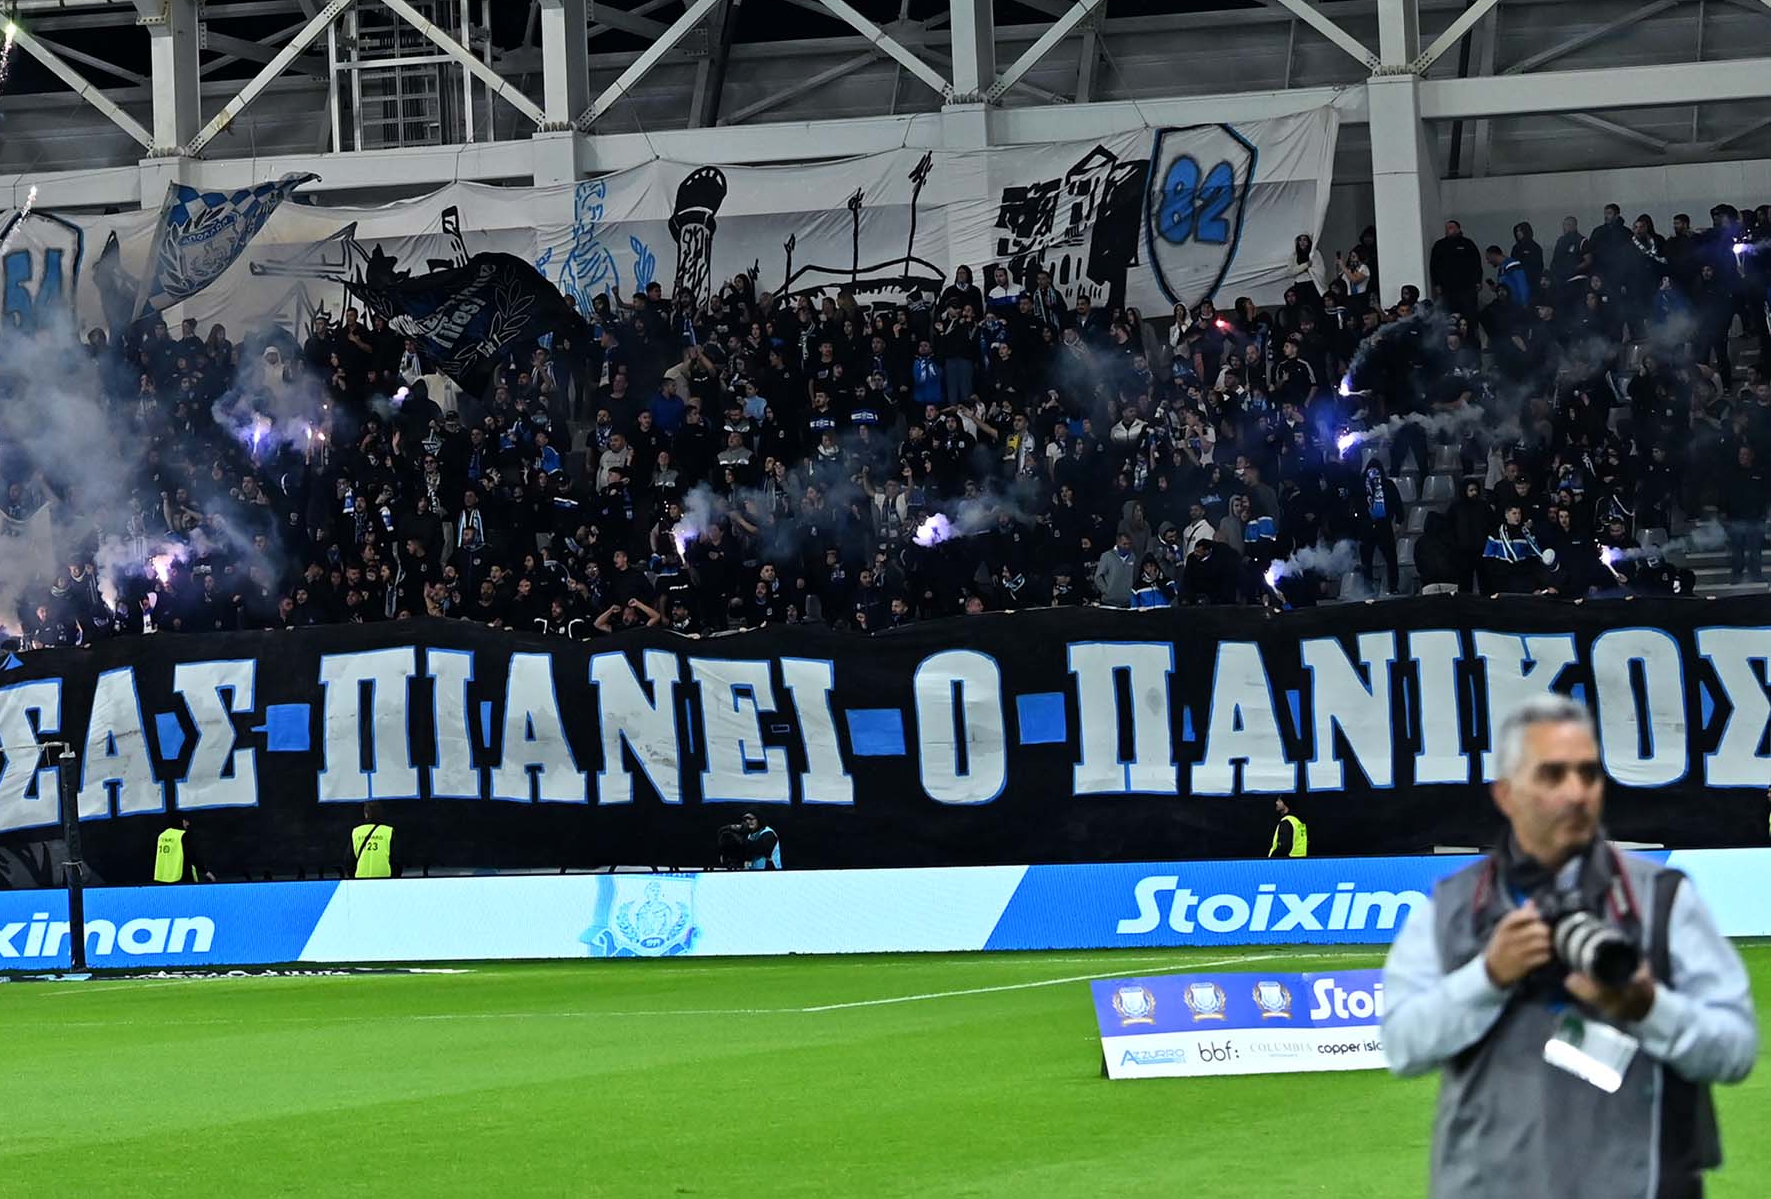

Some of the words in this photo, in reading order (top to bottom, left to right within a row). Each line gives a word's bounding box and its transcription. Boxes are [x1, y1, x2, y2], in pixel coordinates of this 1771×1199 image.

[1156, 155, 1234, 244] 82
[317, 646, 854, 805] ΠΙΑΝΕΙ
[367, 842, 378, 851] 23
[1249, 1041, 1313, 1053] COLUMBIA
[1317, 1041, 1360, 1055] copper
